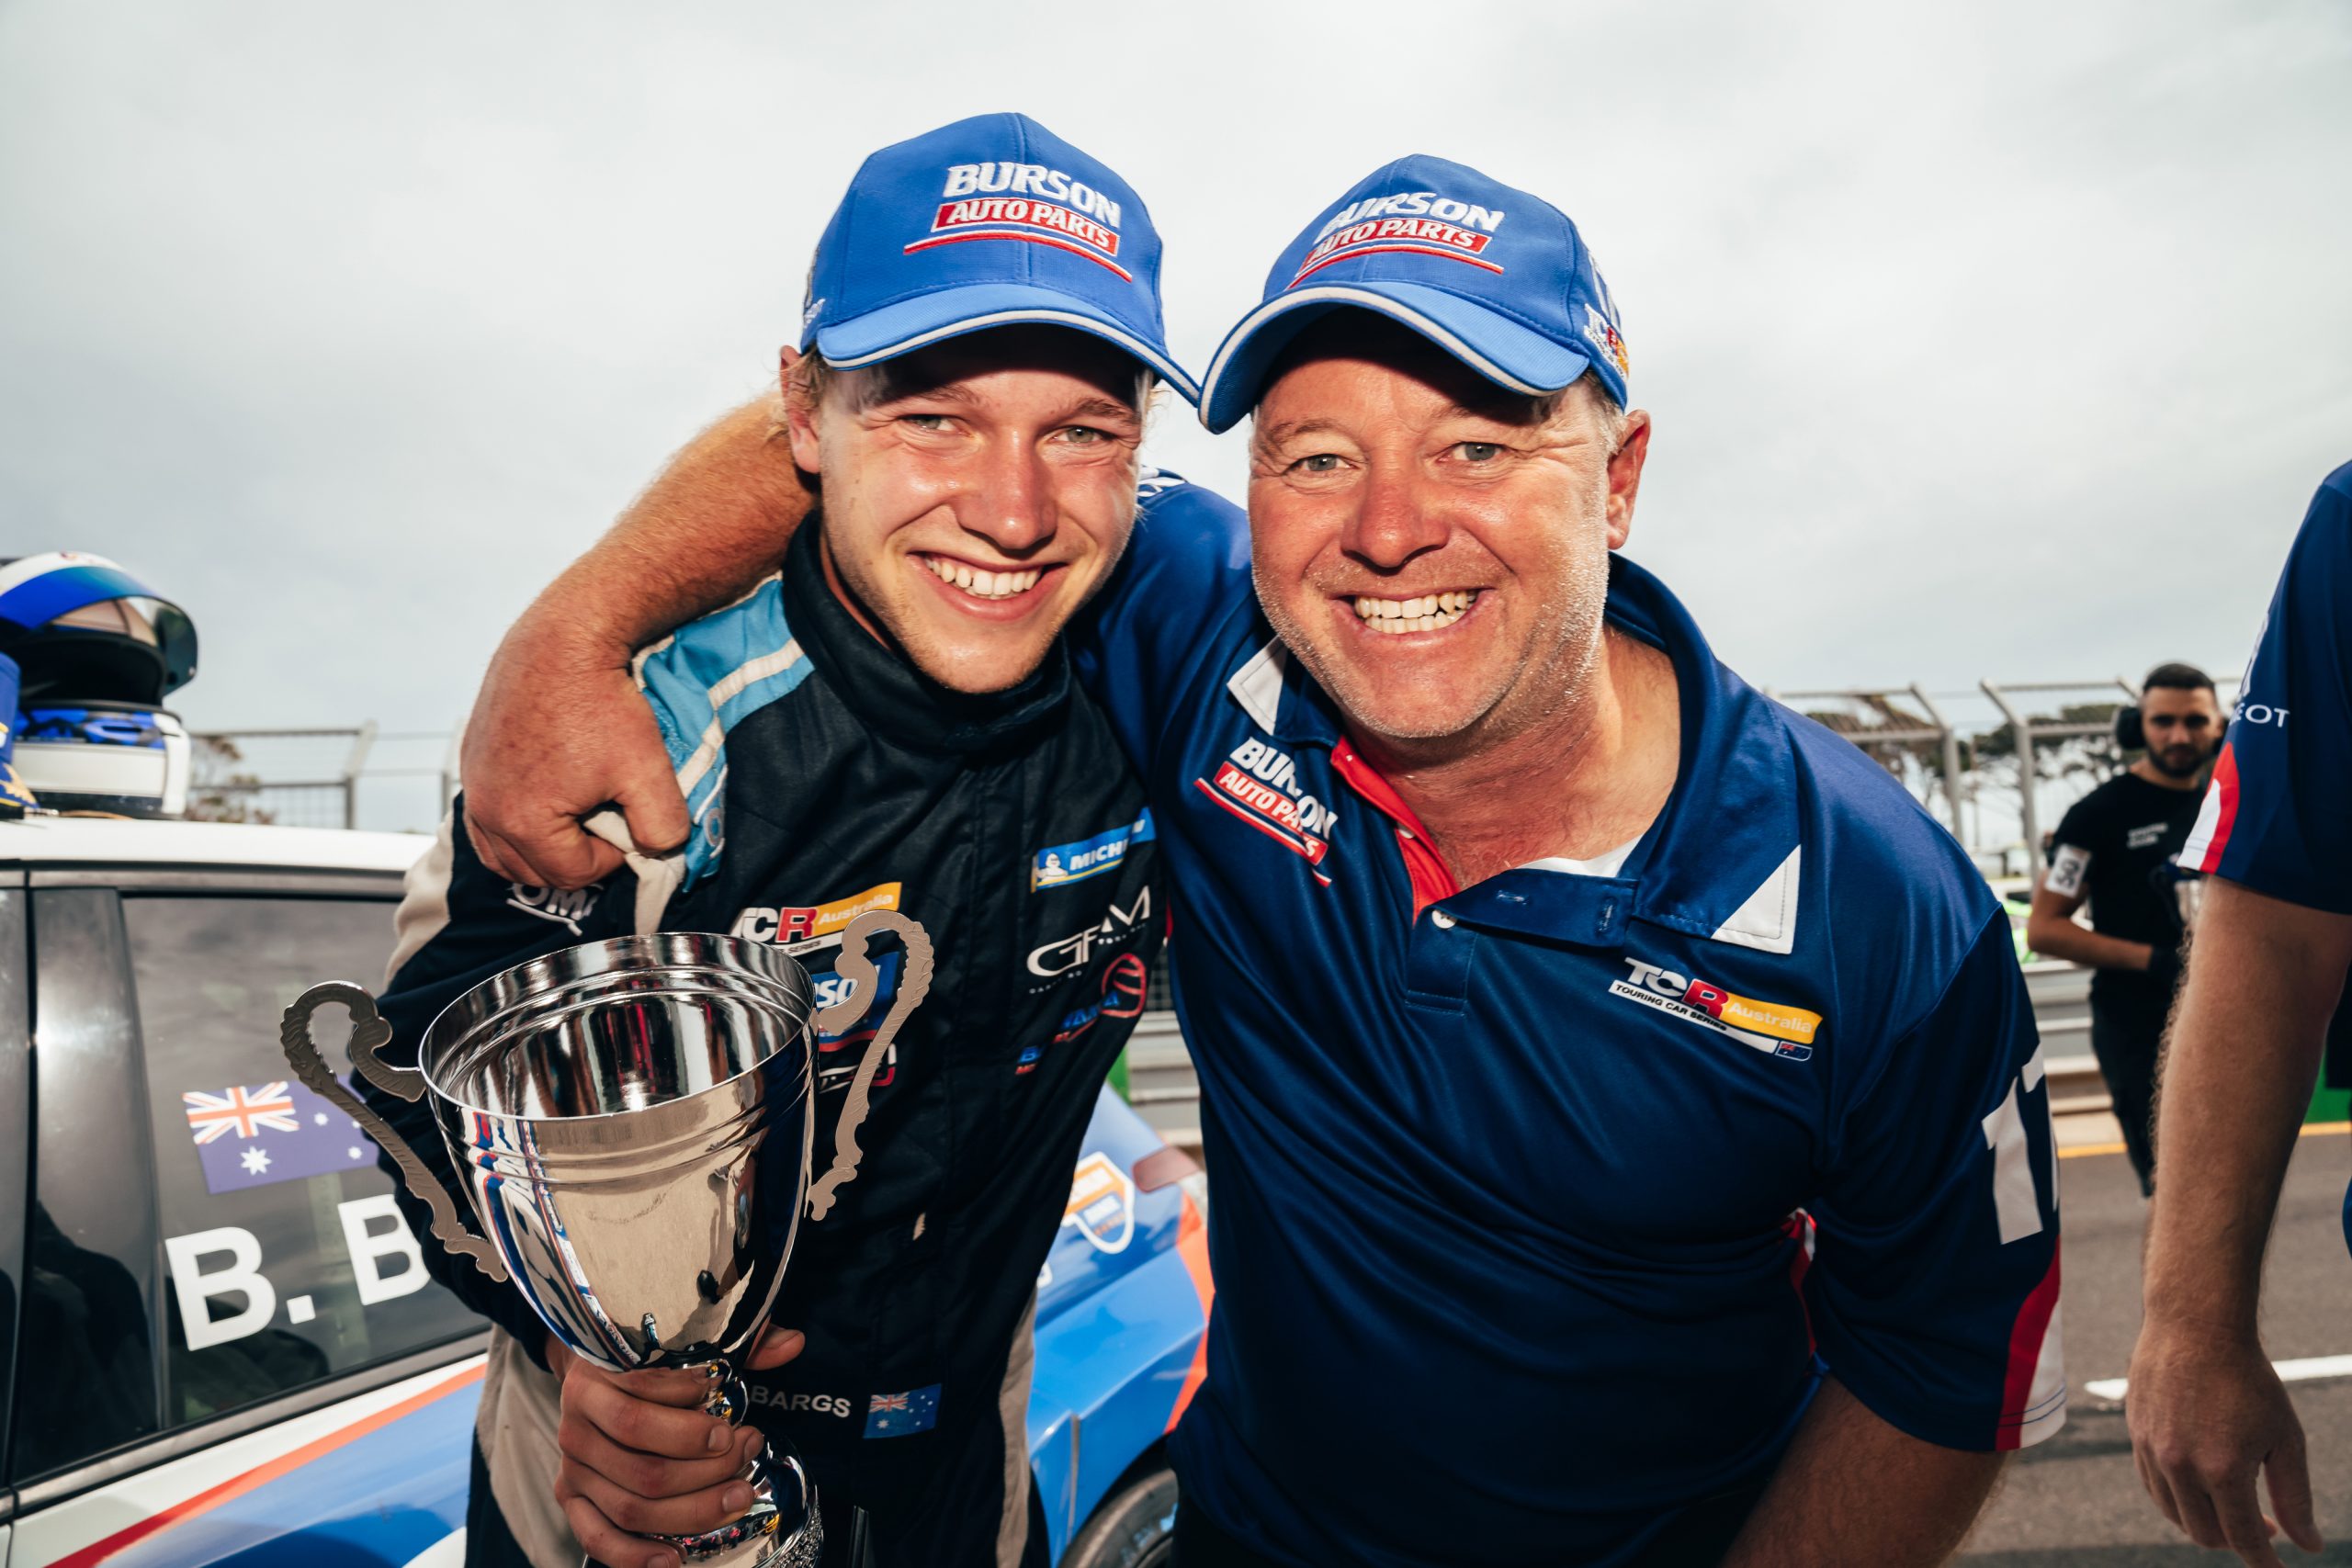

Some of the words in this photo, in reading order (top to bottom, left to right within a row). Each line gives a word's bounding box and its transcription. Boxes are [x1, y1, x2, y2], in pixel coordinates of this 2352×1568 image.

[943, 162, 1121, 229] BURSON
[946, 200, 1028, 224] AUTO
[1031, 204, 1110, 248] PARTS
[1306, 222, 1377, 265] AUTO
[1378, 220, 1476, 247] PARTS
[1219, 770, 1276, 809] AUTO
[1272, 801, 1320, 856] PAS
[1229, 737, 1339, 840] BURON
[818, 894, 894, 925] Australia
[1616, 984, 1663, 1007] TOURING
[1665, 1002, 1689, 1015] CAR
[1624, 956, 1729, 1020] TCR
[1728, 1002, 1813, 1033] Australia
[164, 1226, 316, 1351] B.
[751, 1385, 851, 1417] BARGS
